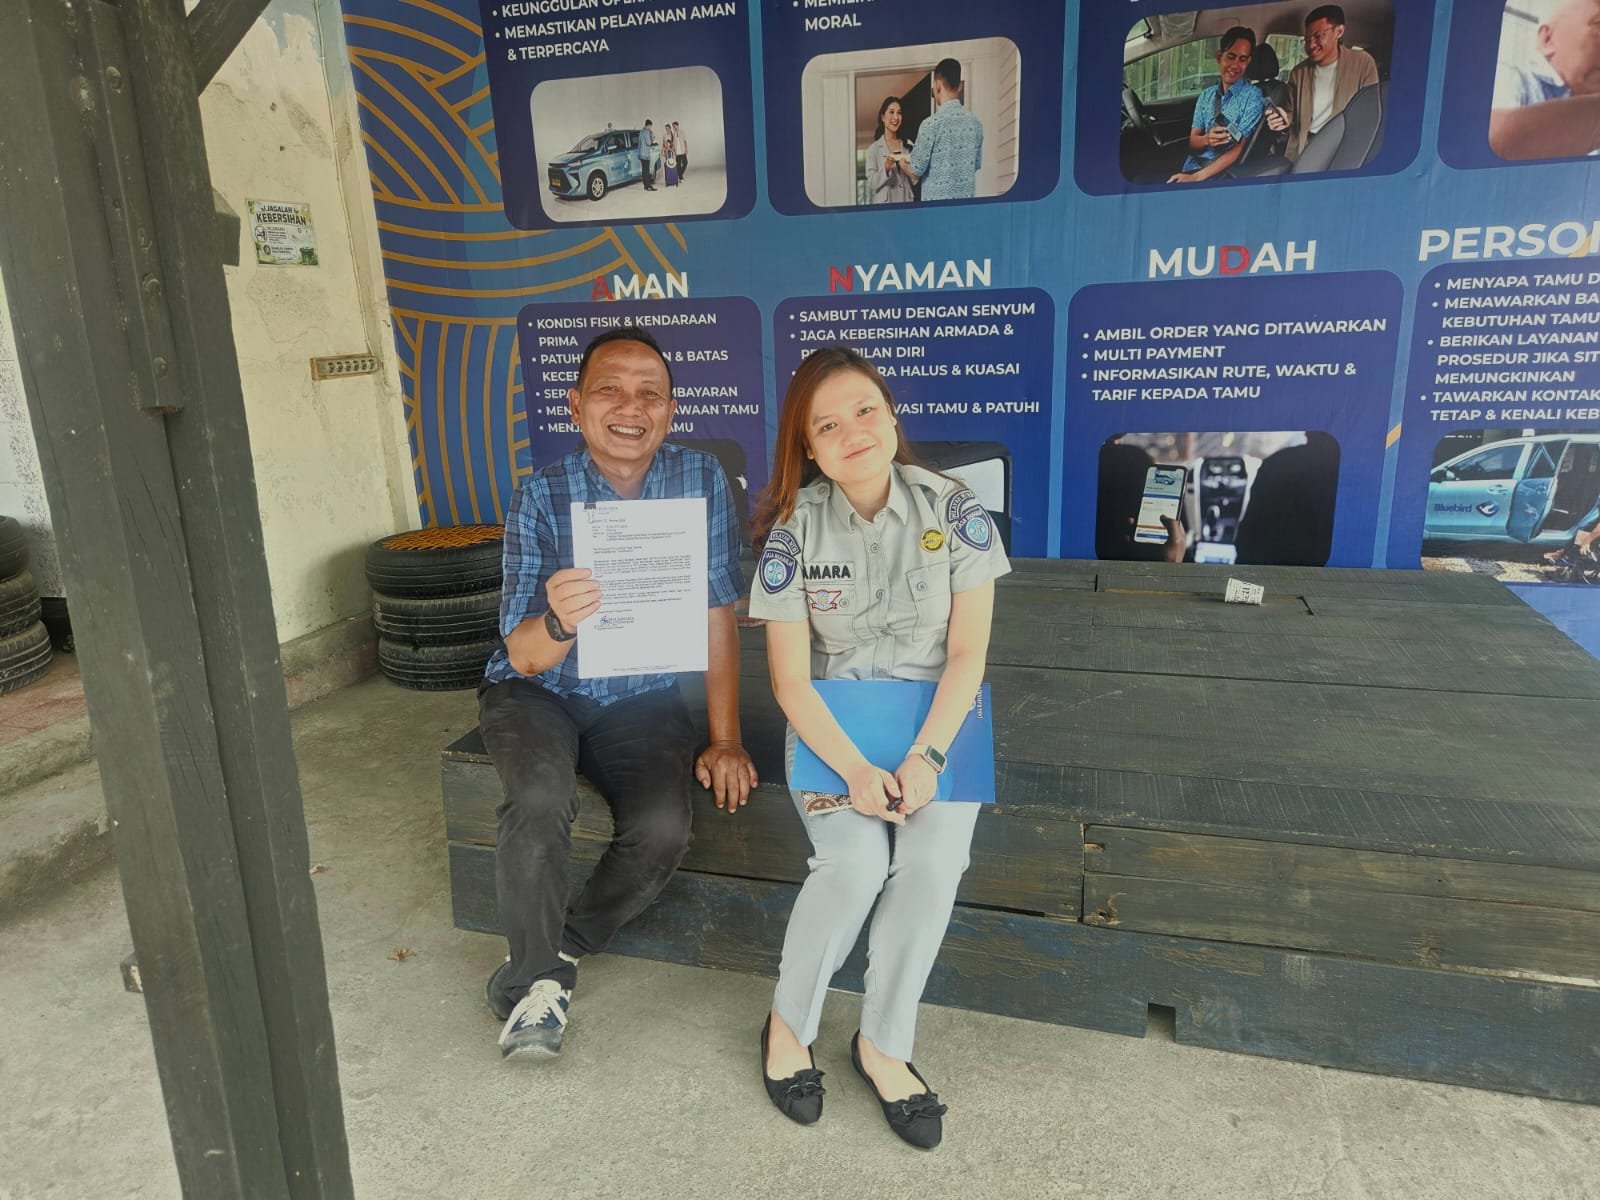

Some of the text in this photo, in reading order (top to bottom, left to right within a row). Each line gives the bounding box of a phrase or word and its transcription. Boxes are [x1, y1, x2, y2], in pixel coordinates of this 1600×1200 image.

[504, 2, 737, 39] MEMASTIKAN PELAYANAN AMAN
[804, 13, 862, 31] MORAL
[507, 38, 610, 61] & TERPERCAYA
[267, 205, 293, 213] JAGALAH
[256, 213, 307, 226] KEBERSIHAN
[1418, 219, 1600, 262] PERSO
[1148, 239, 1317, 278] MUDAH
[828, 258, 992, 293] NYAMAN
[1446, 275, 1529, 291] MENYAPA
[1533, 273, 1584, 287] TAMU
[590, 271, 690, 301] AMAN
[1444, 293, 1571, 310] MENAWARKAN
[799, 302, 1036, 323] SAMBUT TAMU DENGAN SENYUM
[1441, 312, 1600, 329] KEBUTUHAN TAMU
[536, 313, 717, 330] KONDISI FISIK & KENDARAAN
[1093, 317, 1387, 342] AMBIL ORDER YANG DITAWARKAN
[799, 323, 1015, 342] JAGA KEBERSIHAN ARMADA &
[1439, 331, 1599, 348] BERIKAN LAYANAN
[538, 335, 579, 348] PRIMA
[675, 350, 684, 362] &
[686, 349, 729, 362] BATAS
[896, 346, 925, 359] DIRI
[1093, 345, 1226, 362] MULTI PAYMENT
[1437, 352, 1529, 367] PROSEDUR
[1531, 350, 1570, 364] JIKA
[900, 364, 949, 377] HALUS
[951, 364, 962, 376] &
[965, 363, 1020, 376] KUASAI
[1092, 362, 1357, 382] INFORMASIKAN RUTE, WAKTU &
[1434, 370, 1576, 385] MEMUNGKINKAN
[1091, 385, 1261, 401] TARIF KEPADA TAMU
[1432, 389, 1600, 403] TAWARKAN KONTAK
[721, 403, 760, 415] TAMU
[926, 402, 969, 415] TAMU
[971, 402, 982, 414] &
[985, 401, 1040, 414] PATUHI
[1430, 409, 1482, 421] TETAP
[1484, 409, 1497, 421] &
[1500, 408, 1561, 421] KENALI
[1434, 503, 1472, 513] Bluebird
